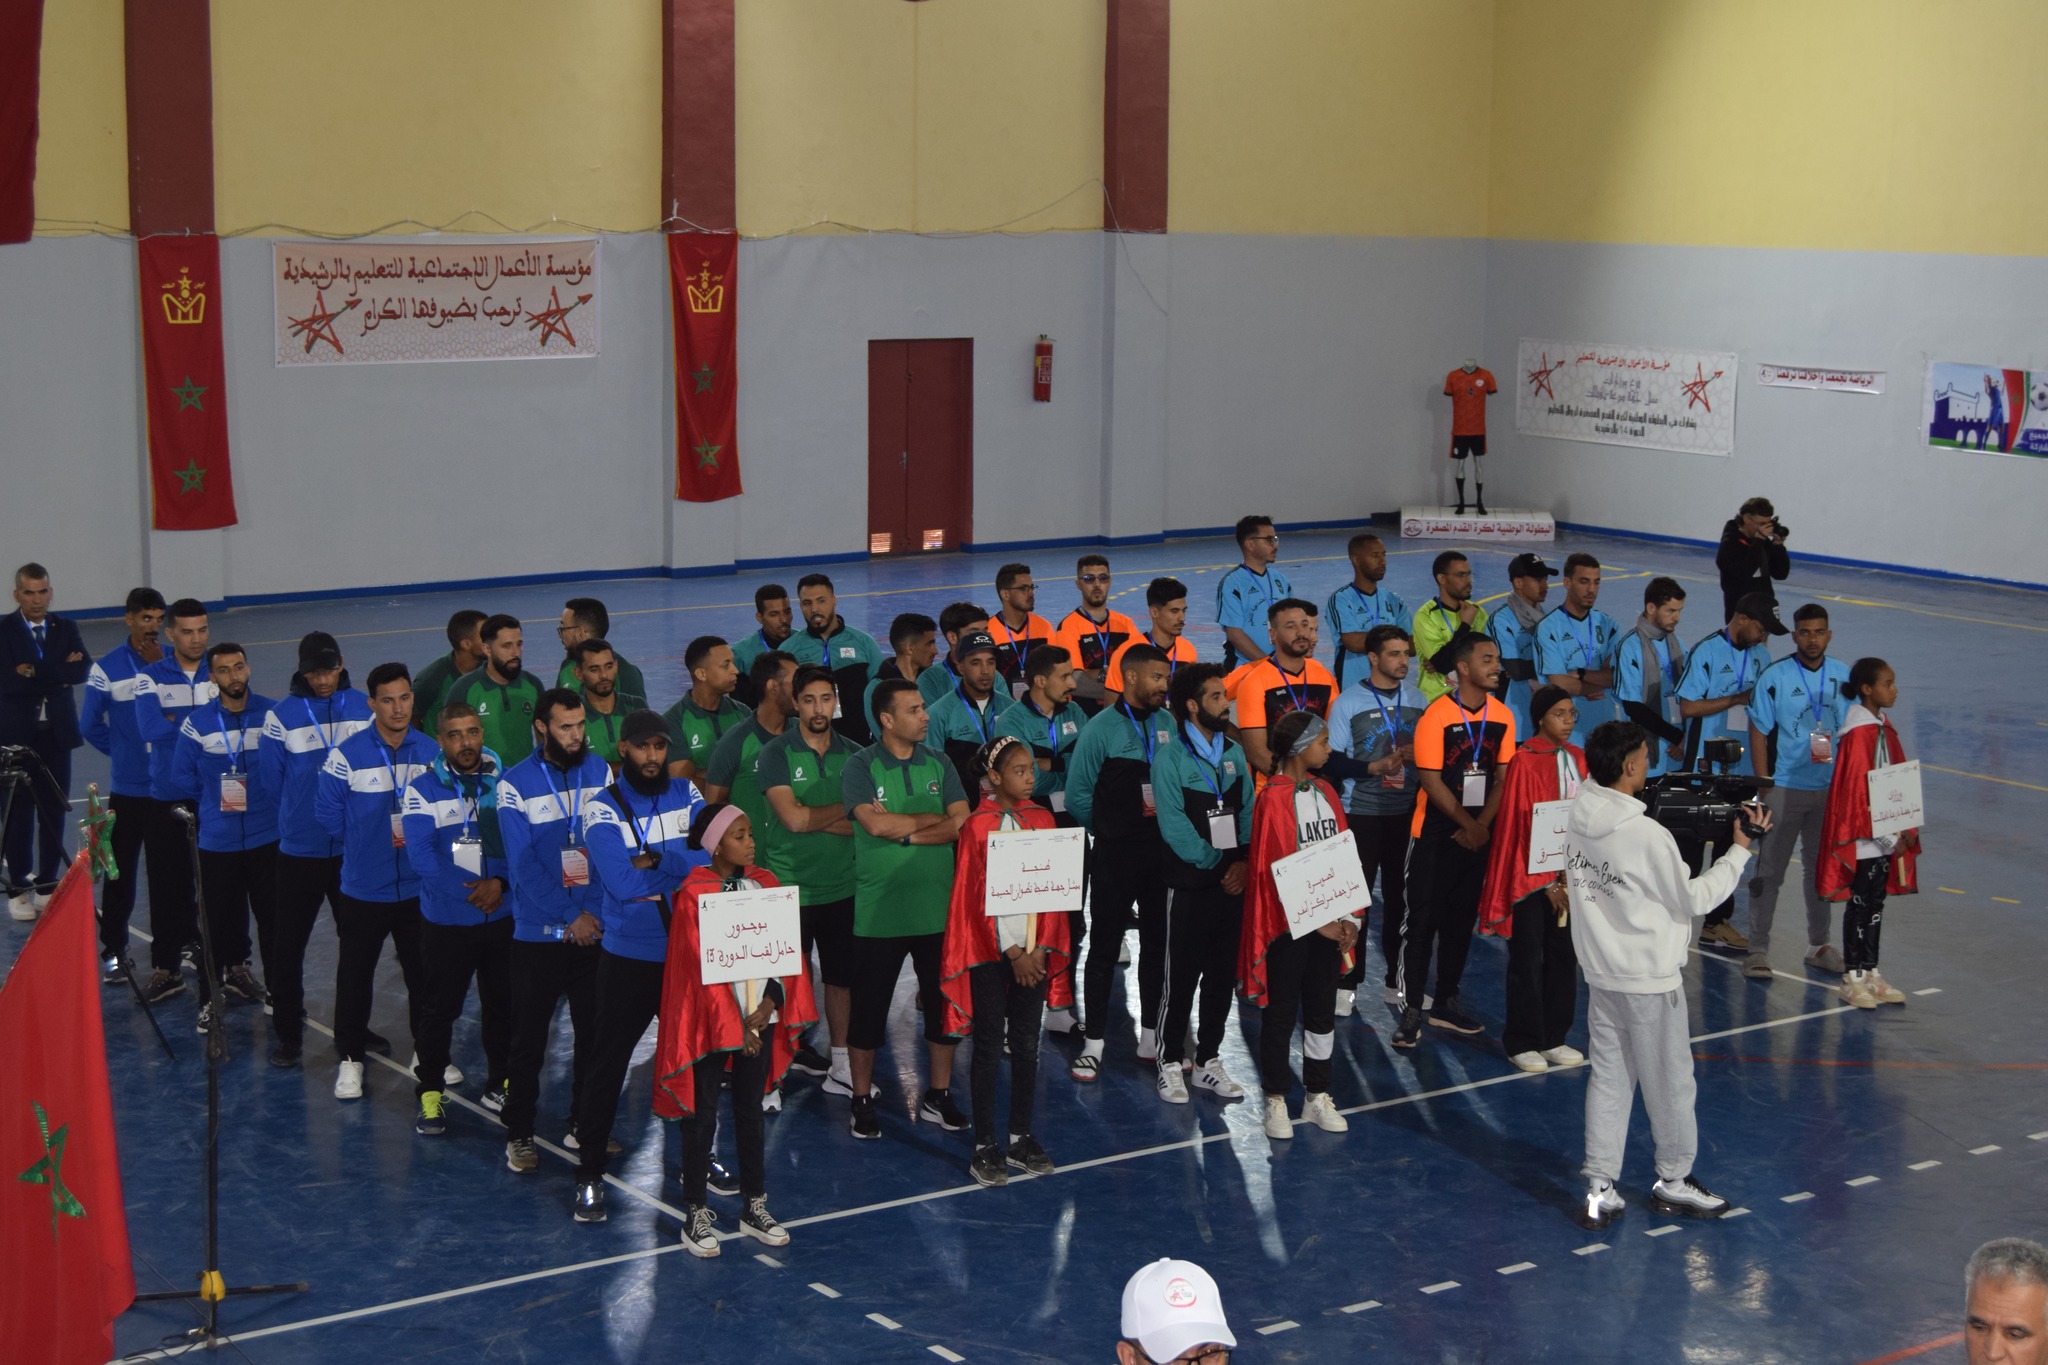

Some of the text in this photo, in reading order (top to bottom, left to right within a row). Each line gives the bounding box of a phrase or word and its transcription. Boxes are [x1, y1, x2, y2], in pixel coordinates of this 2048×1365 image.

[284, 257, 351, 290] بالرشيدية
[349, 257, 403, 296] للتعليم
[474, 249, 541, 291] الأعمال
[546, 254, 591, 285] مؤسسة
[361, 296, 522, 337] ترحب بضيوفها الكرام
[1426, 521, 1553, 536] البطولة الوطنية لكرة القدم المصغرة
[1595, 625, 1604, 645] 8
[1829, 677, 1838, 700] 7
[1299, 818, 1338, 843] LAKER
[1021, 859, 1051, 875] طنجة
[725, 922, 768, 938] بوجدور
[718, 945, 747, 968] الدورة
[750, 942, 772, 960] لقب
[769, 940, 795, 964] حامل
